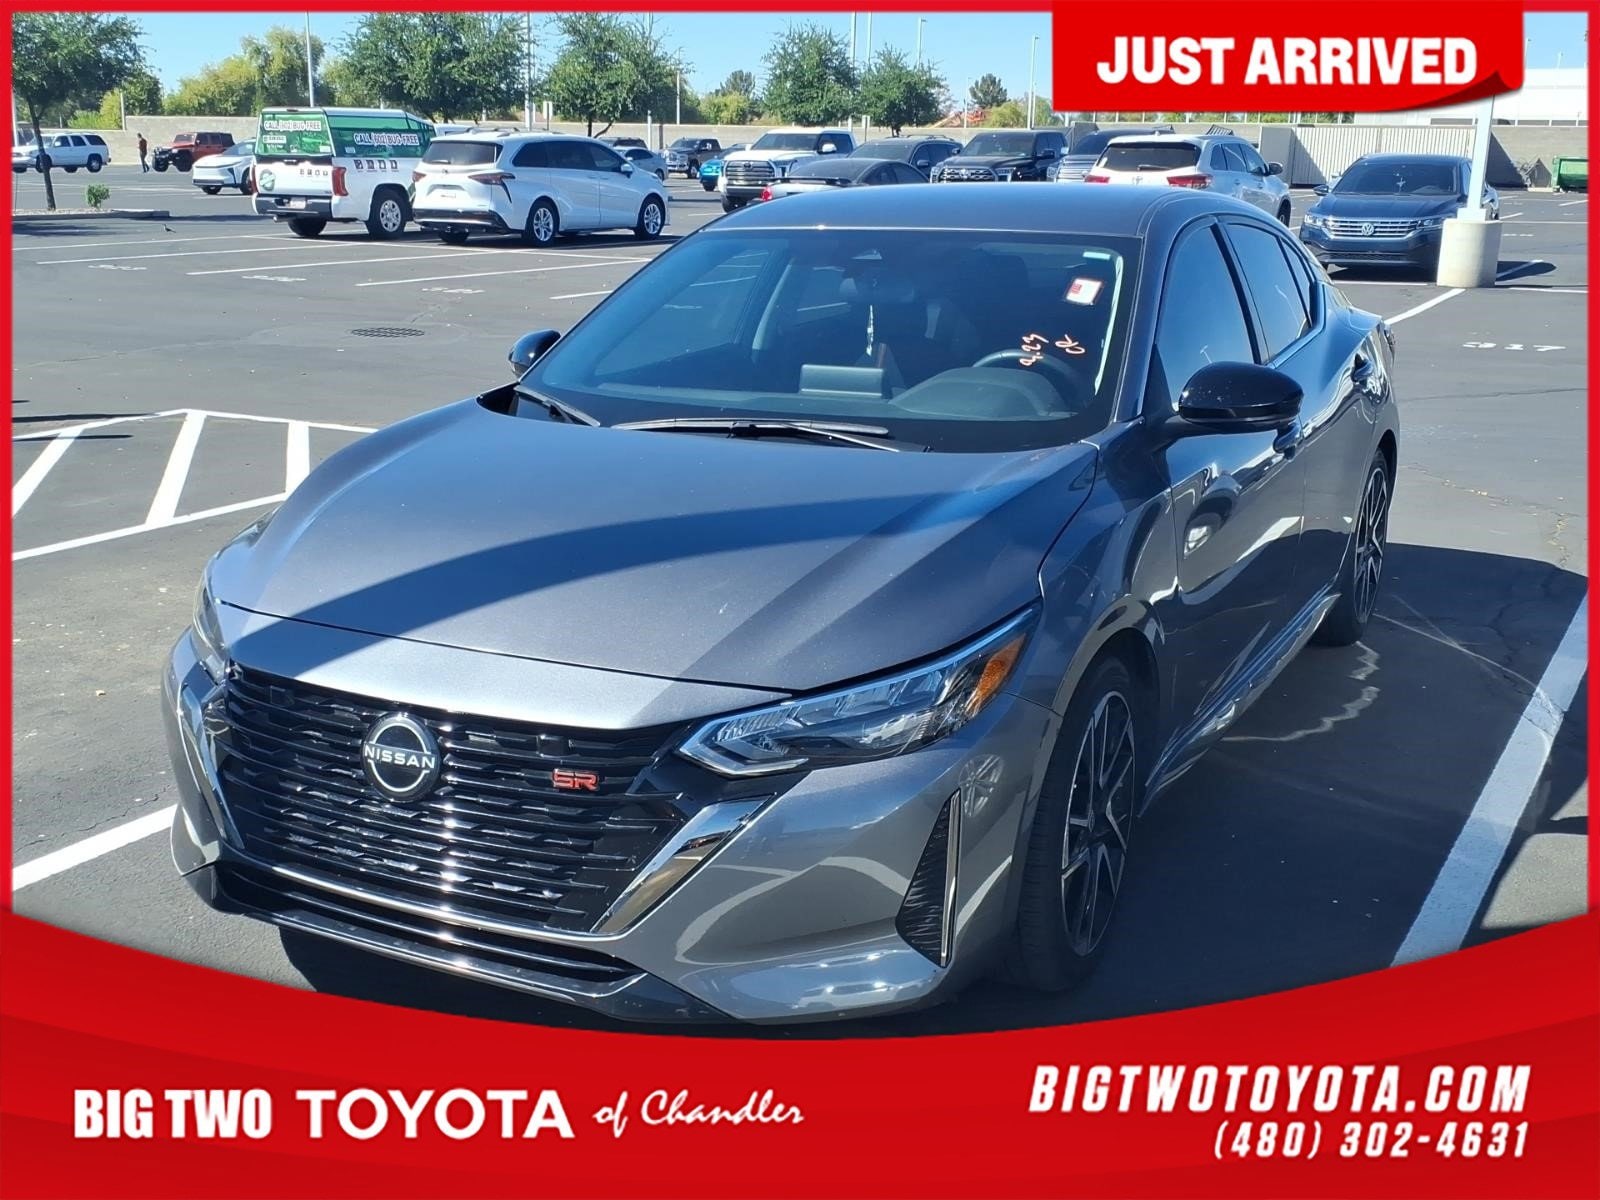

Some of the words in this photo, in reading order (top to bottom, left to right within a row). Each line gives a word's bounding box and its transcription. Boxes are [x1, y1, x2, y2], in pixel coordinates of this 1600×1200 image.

[264, 121, 279, 131] CALL
[354, 133, 371, 145] CALL
[364, 745, 436, 769] NISSAN
[553, 768, 599, 790] SR
